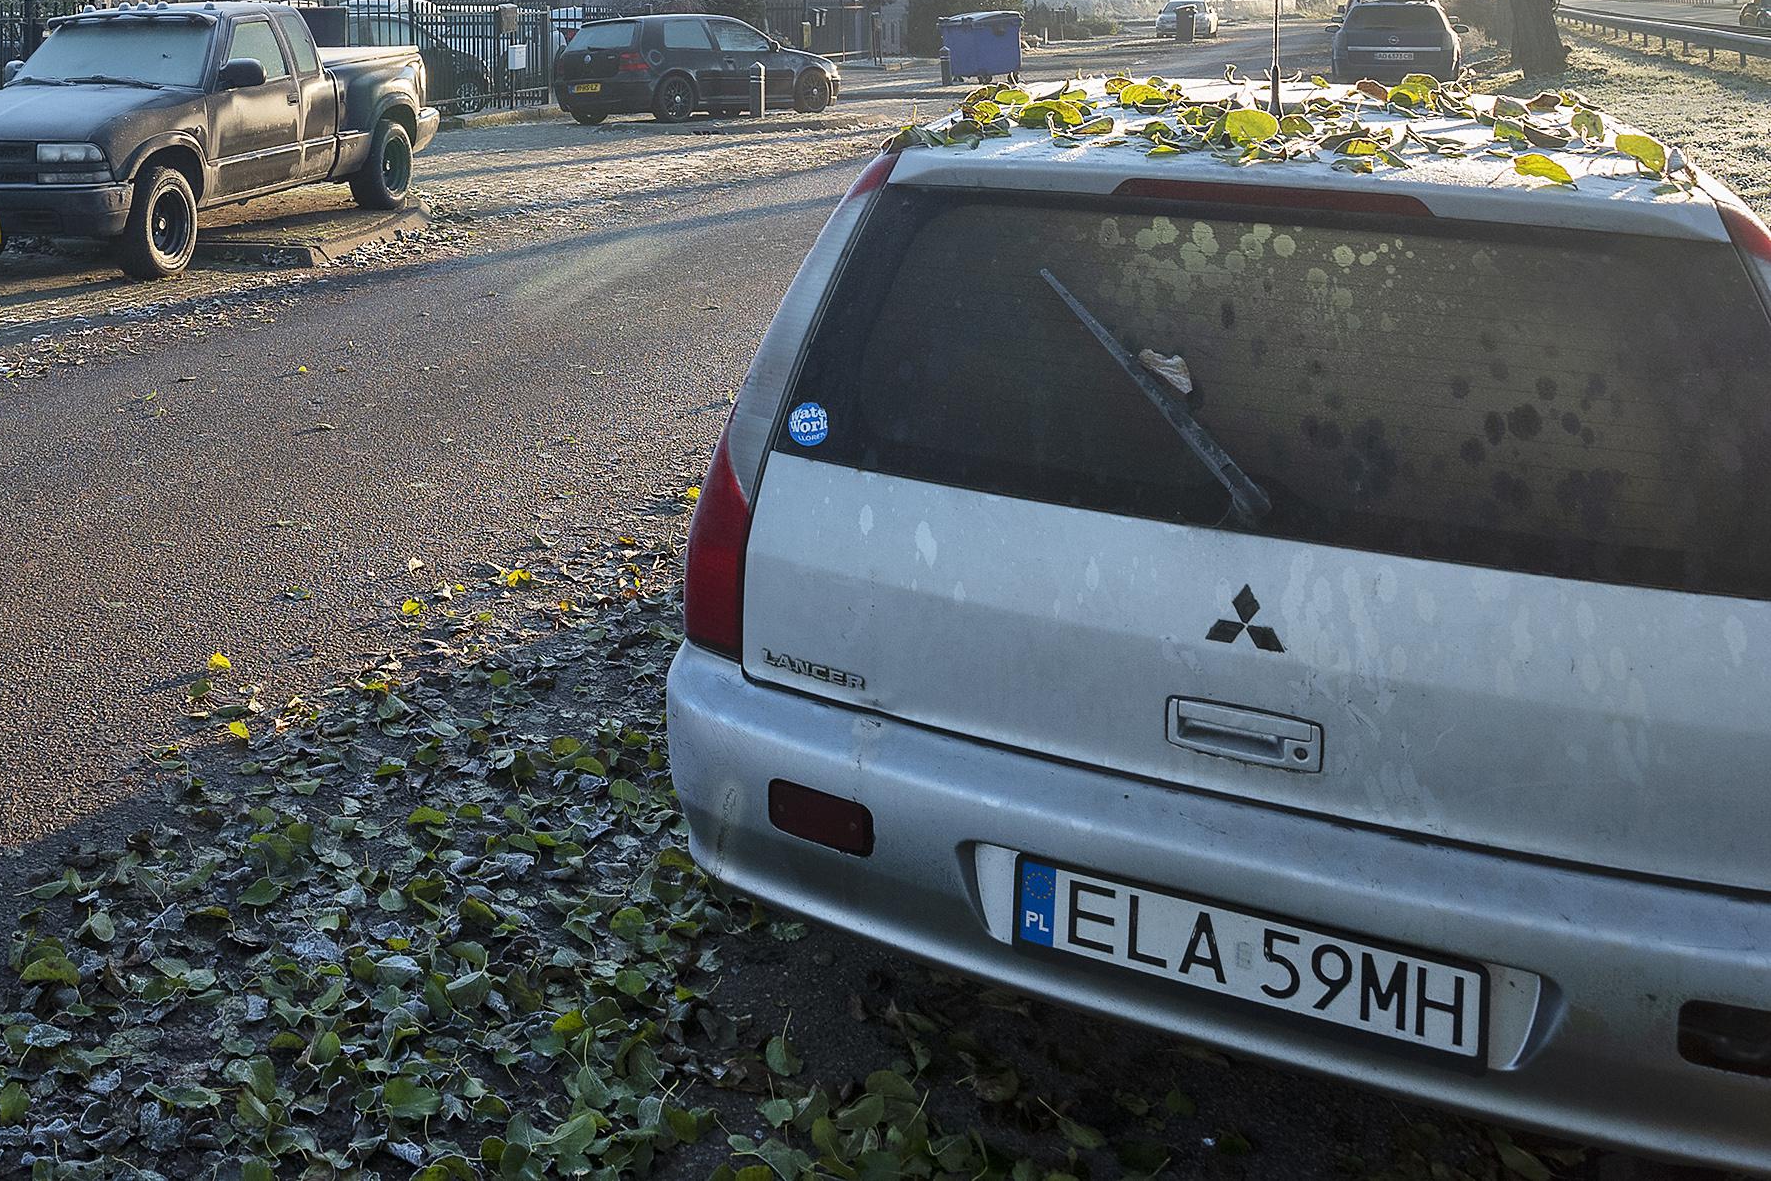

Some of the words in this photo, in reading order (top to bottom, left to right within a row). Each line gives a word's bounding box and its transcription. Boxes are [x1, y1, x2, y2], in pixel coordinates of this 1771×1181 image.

[762, 647, 866, 691] LANCER
[1024, 910, 1050, 934] PL
[1067, 879, 1227, 985] ELA
[1260, 927, 1465, 1047] 59MH
